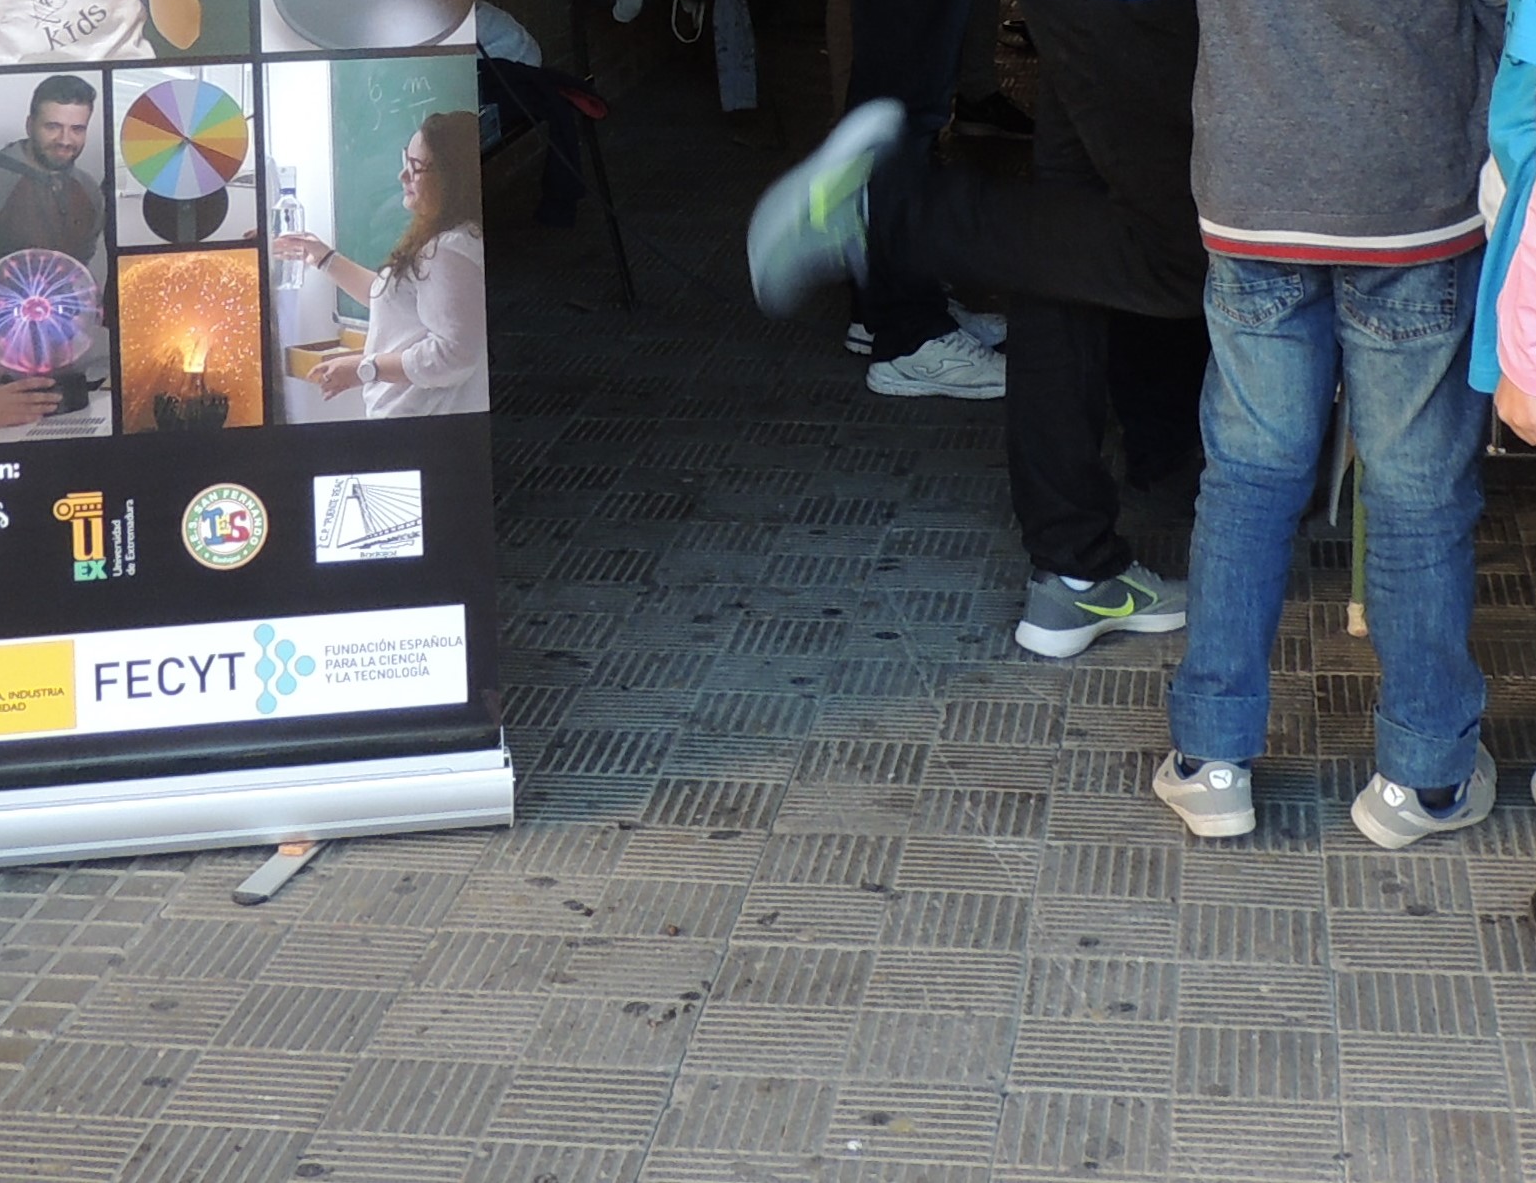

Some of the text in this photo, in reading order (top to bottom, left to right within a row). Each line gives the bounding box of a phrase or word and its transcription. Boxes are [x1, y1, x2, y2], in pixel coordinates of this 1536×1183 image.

[43, 4, 108, 51] kids
[194, 492, 219, 514] SAN
[223, 489, 263, 546] FERNANDO
[111, 519, 123, 577] Universidad
[124, 499, 136, 576] de Extremadura
[74, 559, 108, 581] EX
[325, 635, 464, 657] FUNDACIÓN ESPAÑOLA
[325, 652, 428, 670] PARA LA CIENCIA
[94, 651, 246, 702] FECYT
[325, 662, 431, 684] Y LA TECNOLOGÍA
[8, 687, 65, 700] INDUSTRIA
